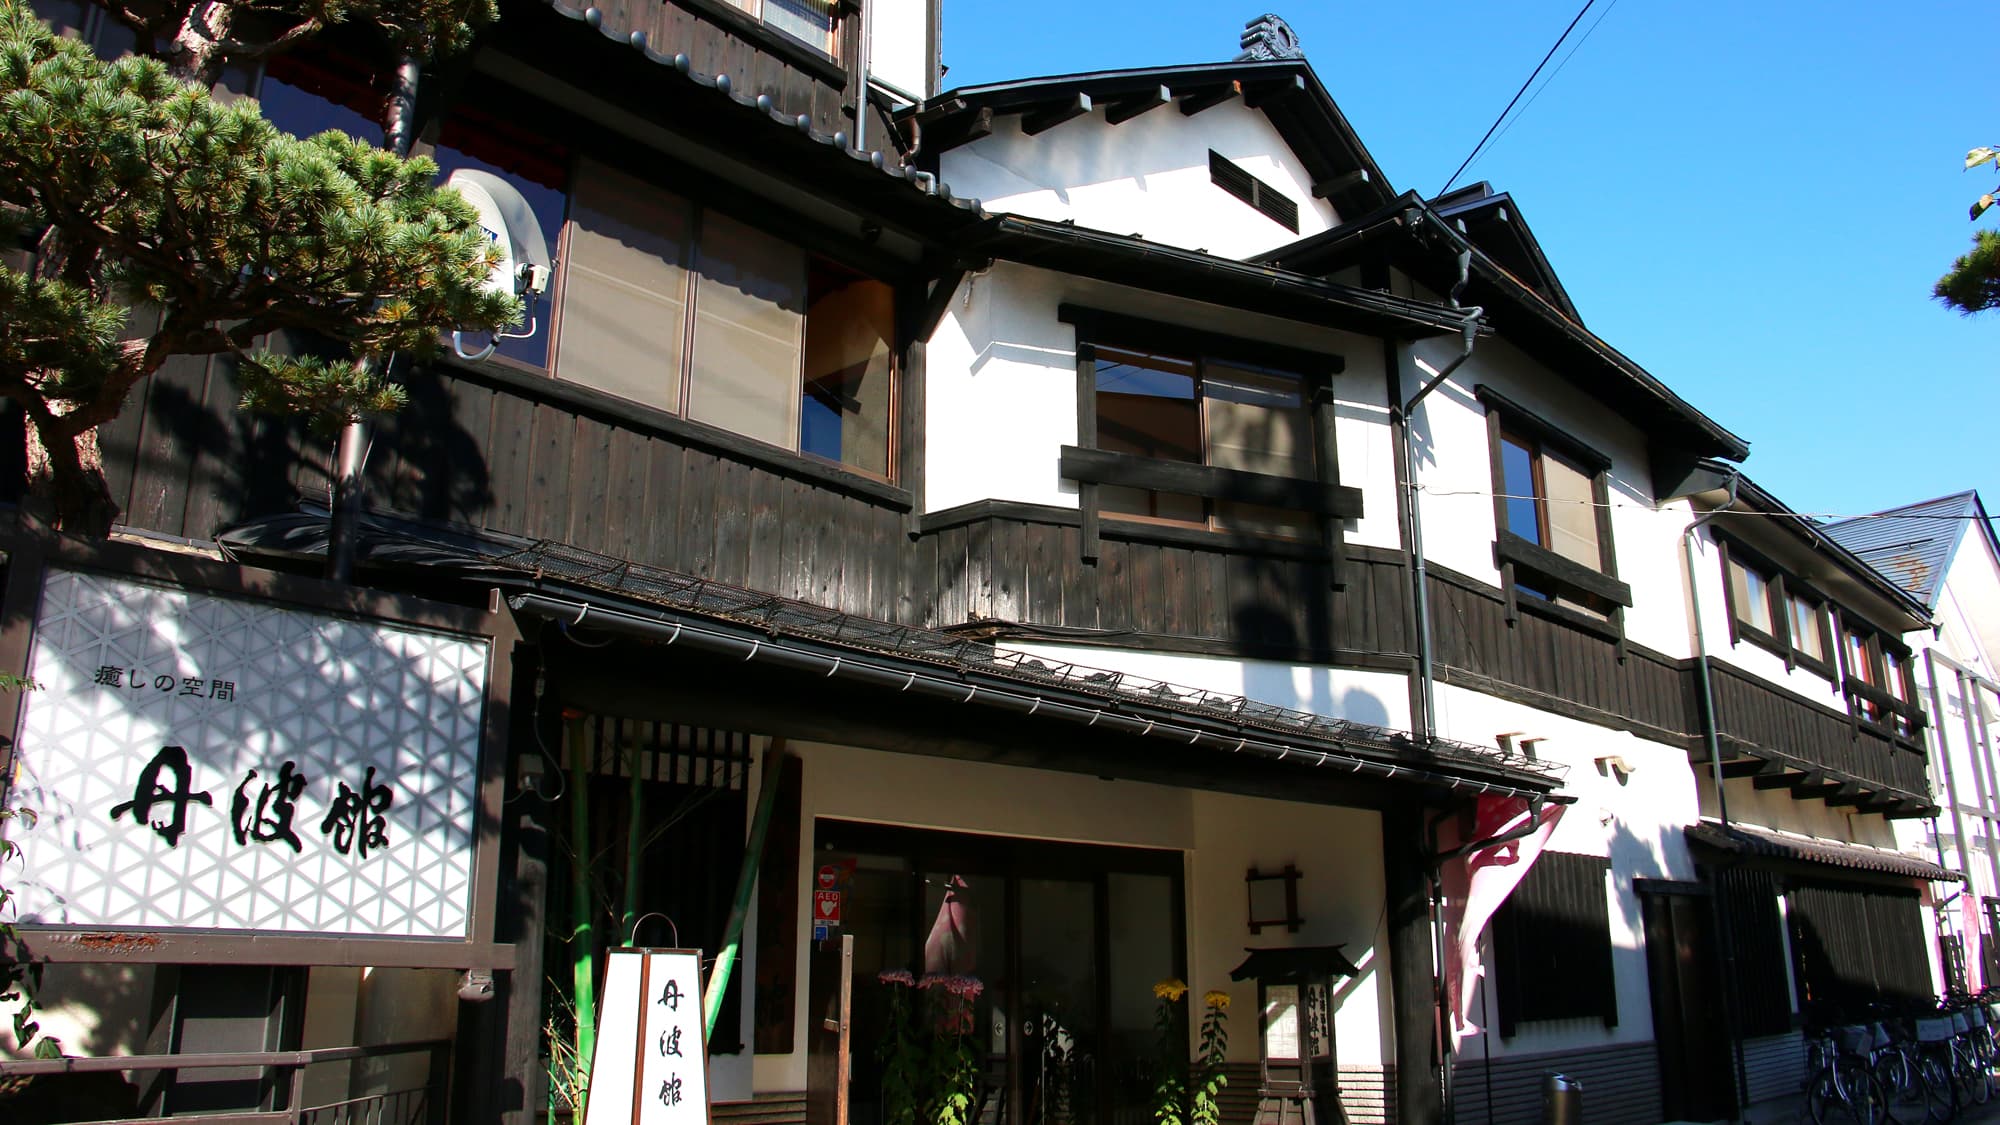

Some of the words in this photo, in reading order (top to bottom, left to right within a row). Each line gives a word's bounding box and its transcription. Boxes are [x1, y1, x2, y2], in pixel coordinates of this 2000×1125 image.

[94, 665, 236, 702] 癒しの空間
[110, 746, 394, 860] 丹波館
[817, 892, 839, 901] AED
[657, 979, 685, 1107] 丹波館
